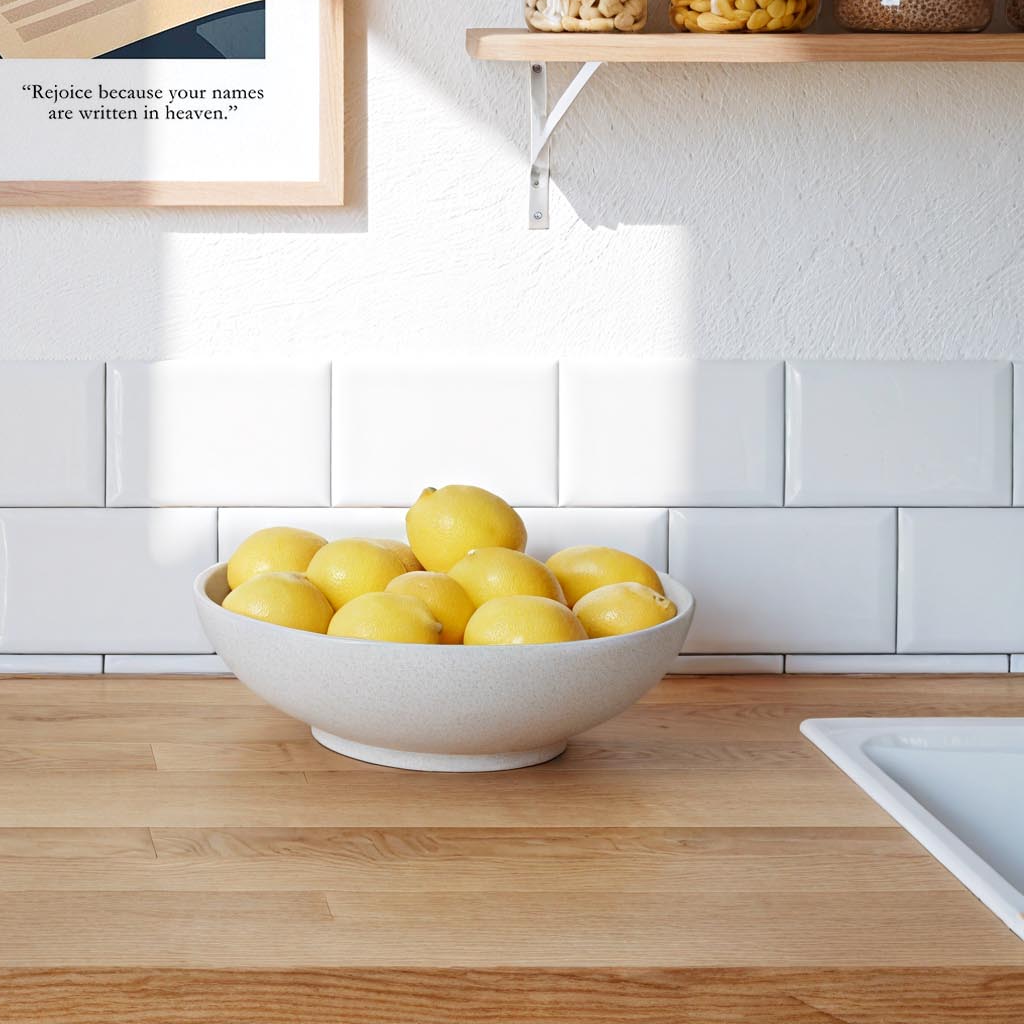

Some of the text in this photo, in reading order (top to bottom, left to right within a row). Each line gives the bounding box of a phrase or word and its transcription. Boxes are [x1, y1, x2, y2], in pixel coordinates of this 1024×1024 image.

[21, 83, 265, 105] “Rejoice because your names
[48, 104, 238, 120] are written in heaven.”
